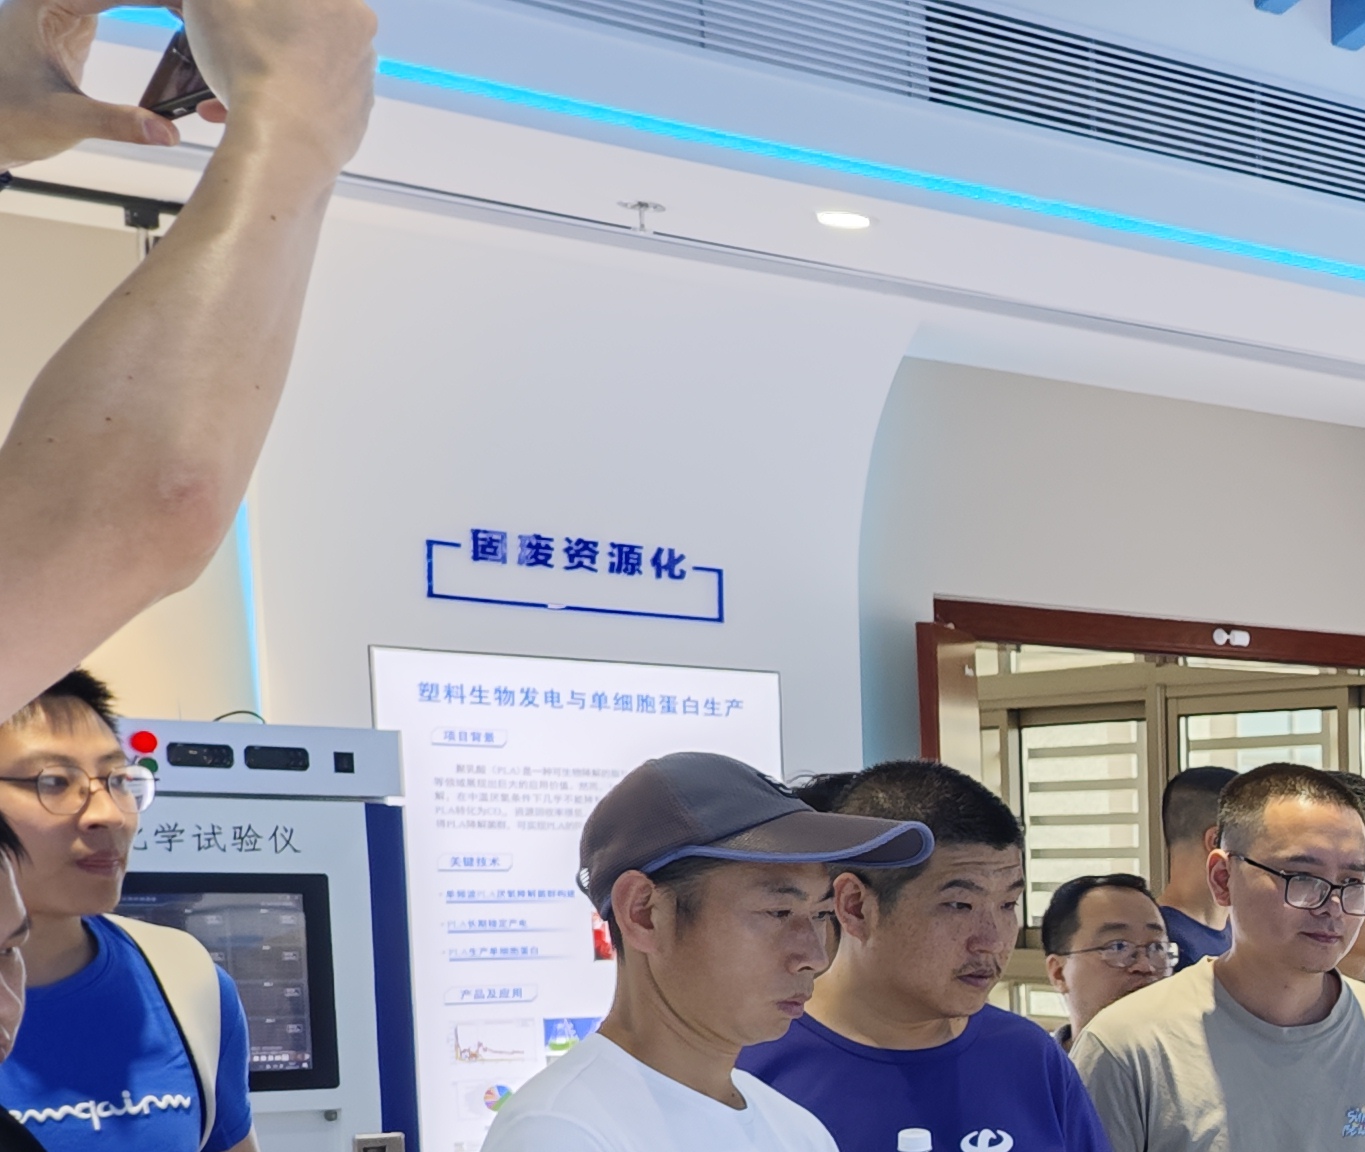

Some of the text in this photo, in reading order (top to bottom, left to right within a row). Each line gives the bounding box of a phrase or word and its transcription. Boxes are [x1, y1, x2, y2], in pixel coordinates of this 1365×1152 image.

[470, 528, 687, 580] 固废资源化
[418, 681, 744, 719] 塑料生物发电与单细胞蛋白生产
